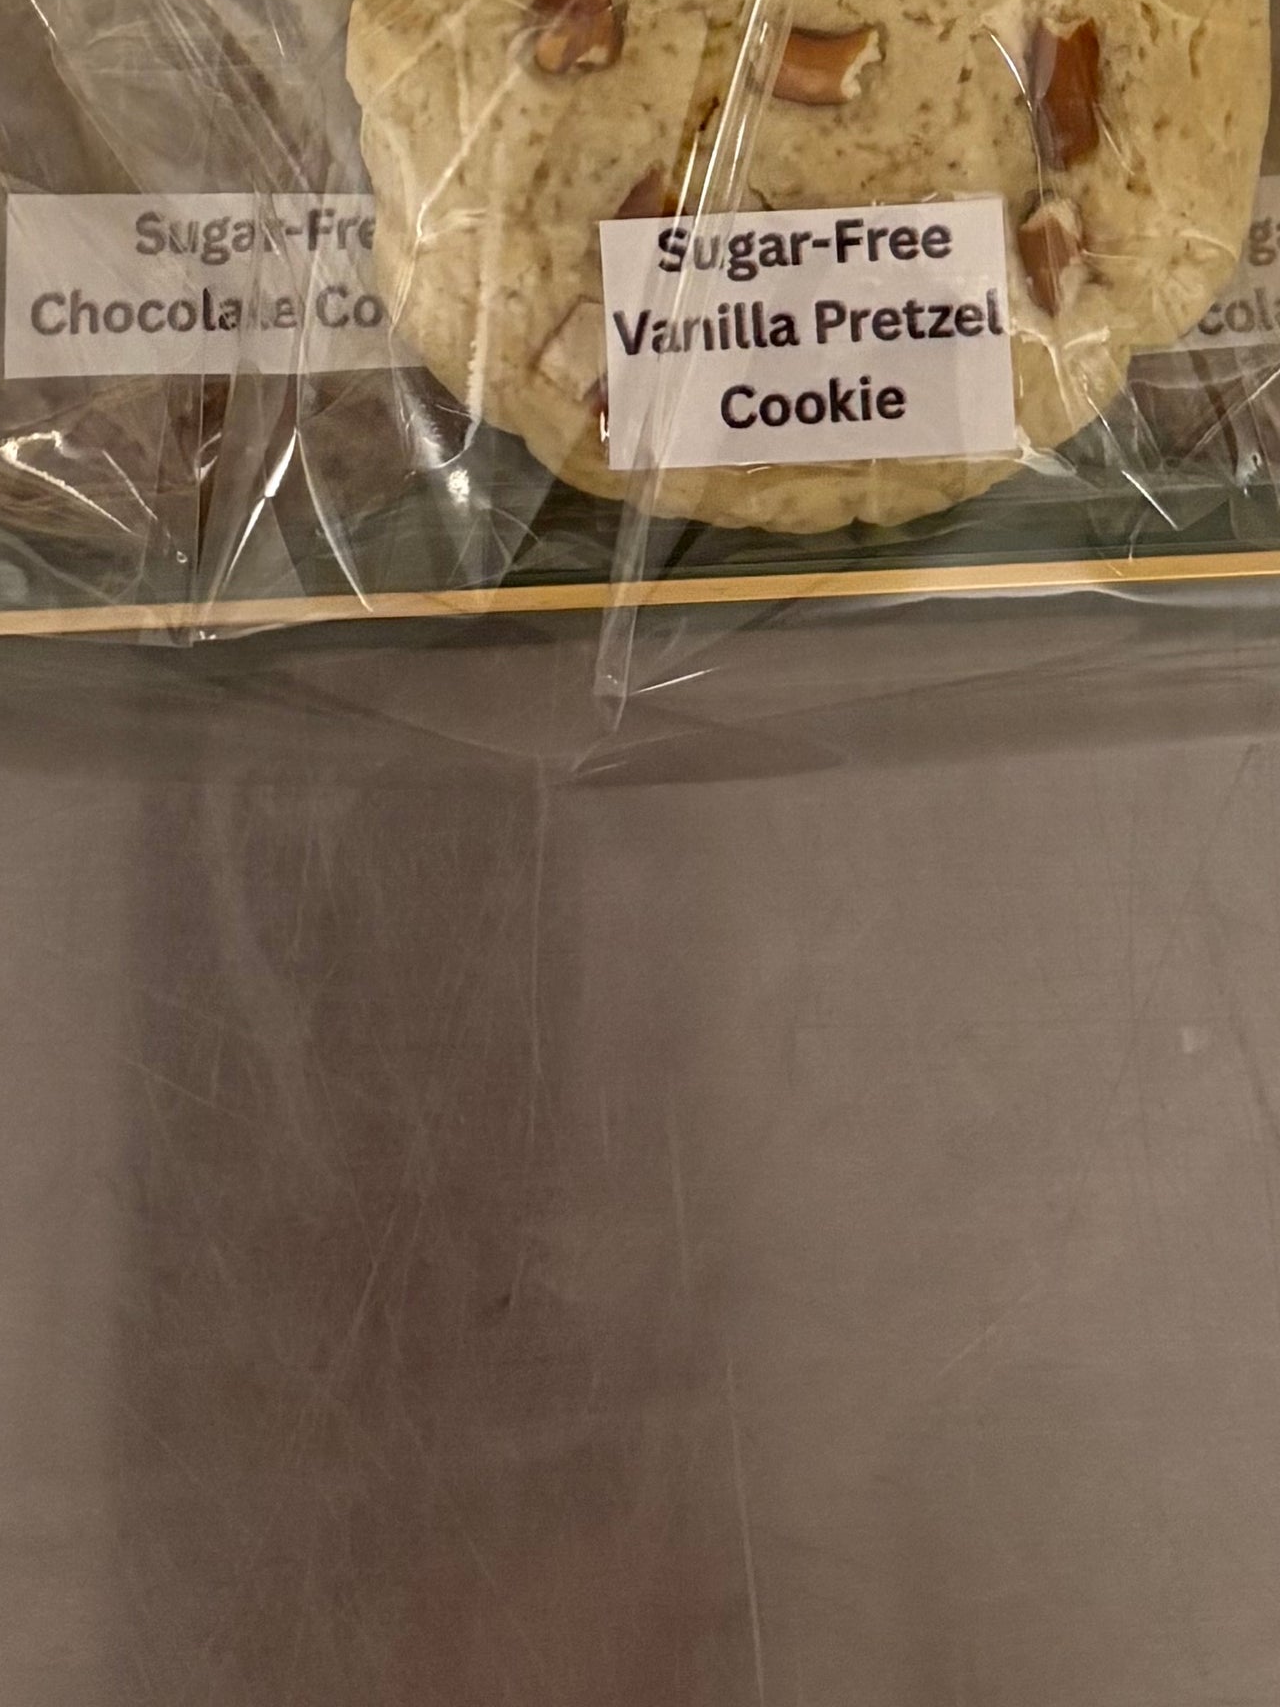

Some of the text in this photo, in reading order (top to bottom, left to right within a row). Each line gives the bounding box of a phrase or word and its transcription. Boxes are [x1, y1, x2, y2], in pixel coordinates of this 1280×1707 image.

[657, 218, 953, 282] Sugar-Free
[613, 287, 1004, 355] Vanilla Pretzel
[721, 375, 907, 429] Cookie
